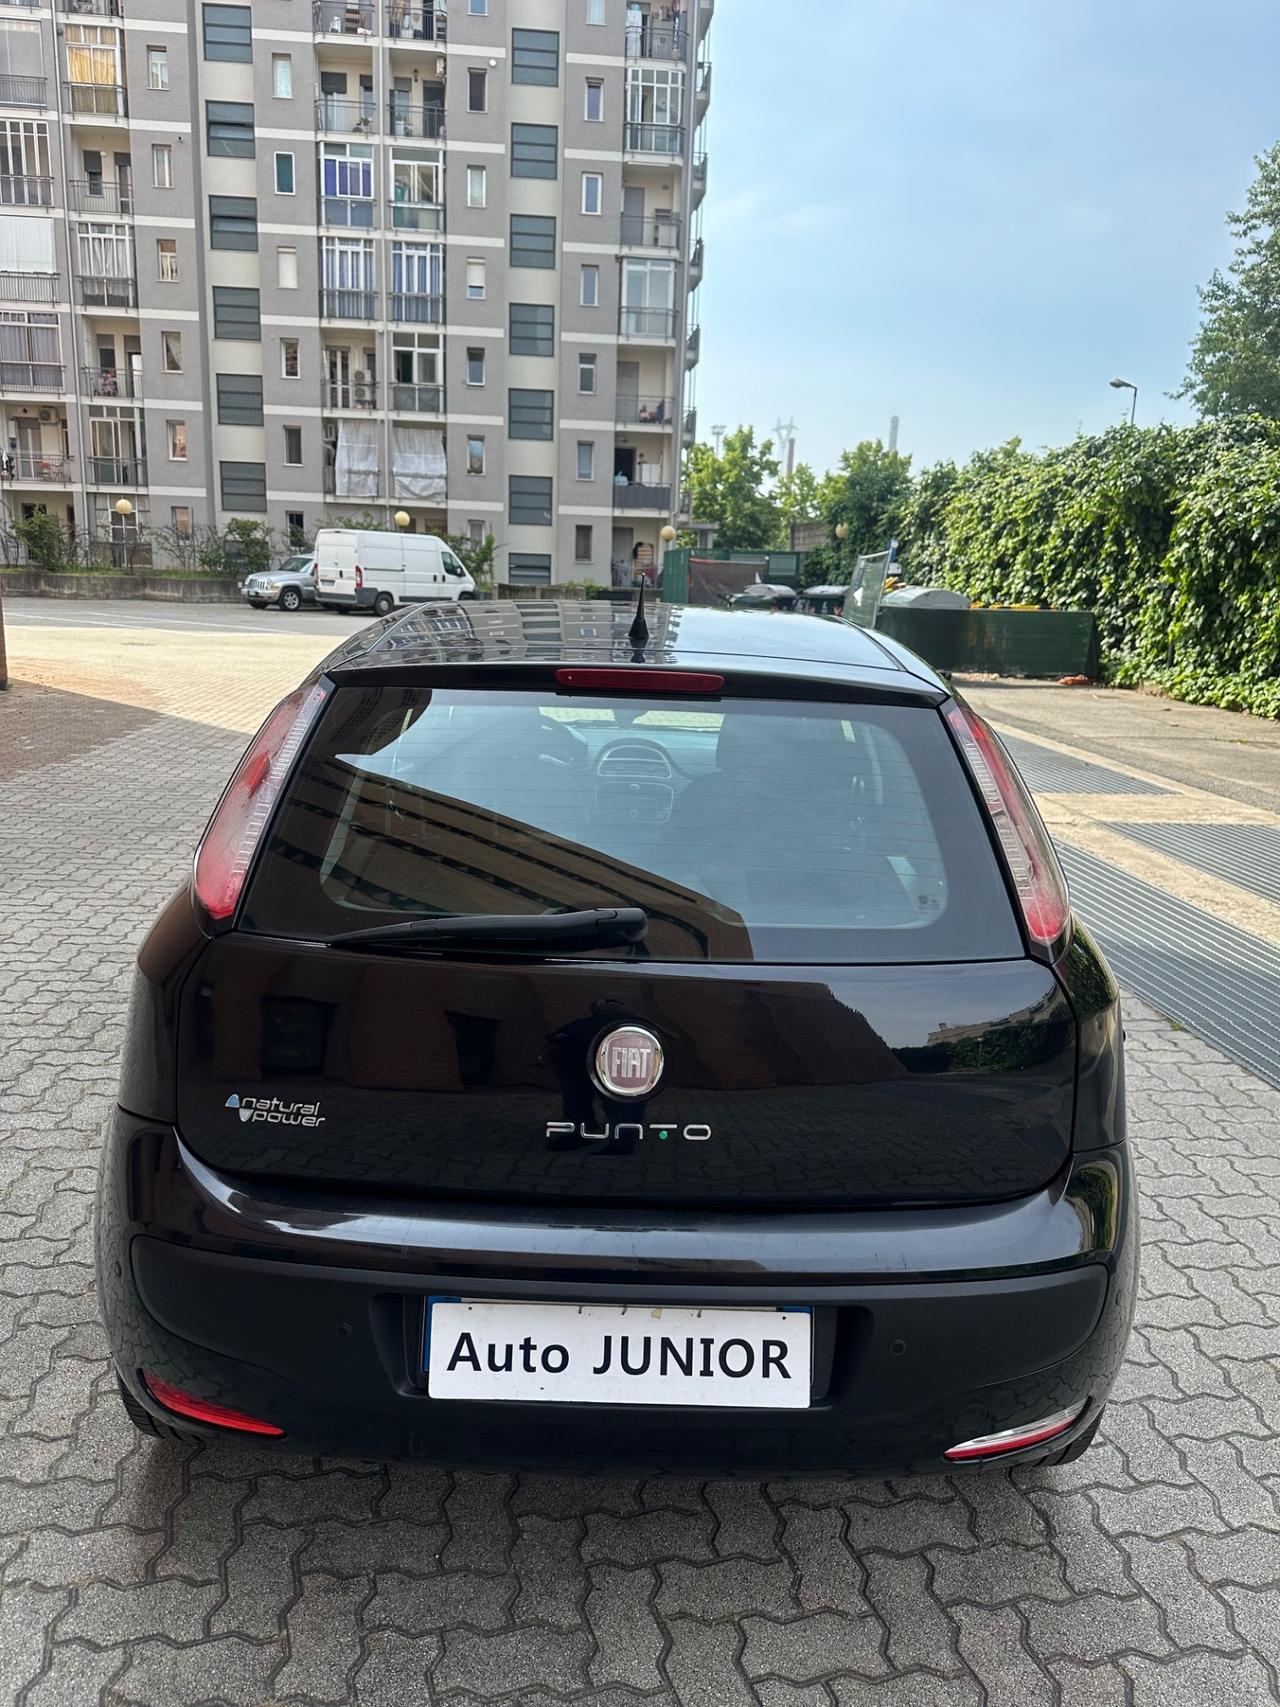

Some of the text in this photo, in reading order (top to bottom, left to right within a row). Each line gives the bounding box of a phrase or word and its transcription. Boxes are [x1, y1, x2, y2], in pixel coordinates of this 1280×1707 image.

[611, 1047, 650, 1078] FIAT
[241, 1096, 320, 1116] natural
[251, 1110, 326, 1127] power
[446, 1332, 792, 1379] Auto JUNIOR
